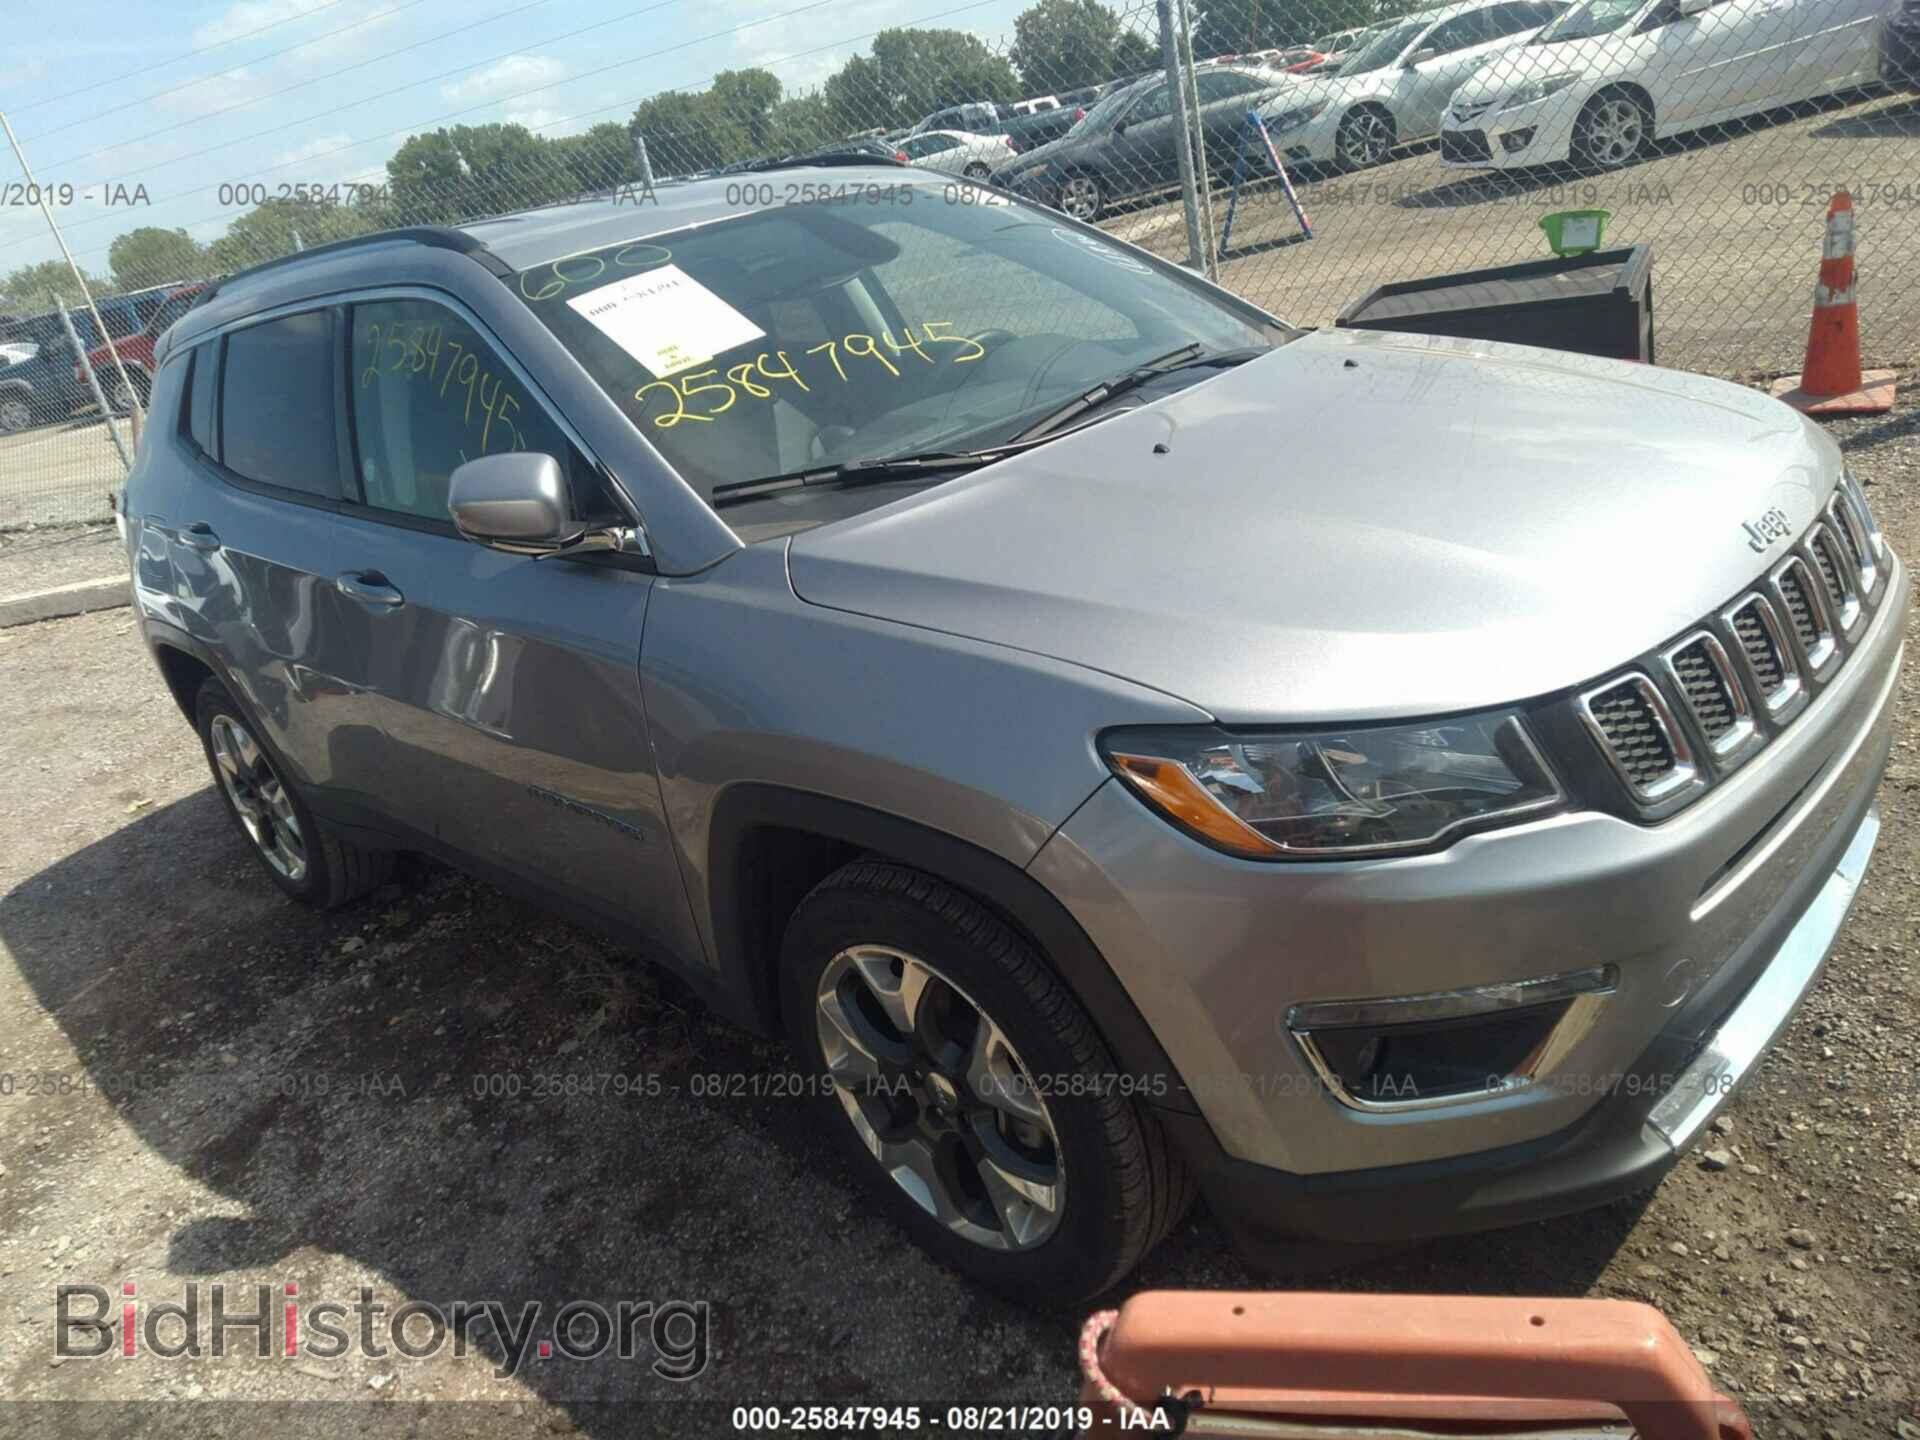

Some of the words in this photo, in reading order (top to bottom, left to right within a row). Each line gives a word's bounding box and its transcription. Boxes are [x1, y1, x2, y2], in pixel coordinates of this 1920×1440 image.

[361, 320, 524, 456] 25847945
[635, 322, 987, 428] 25847945
[1741, 506, 1792, 554] Jeep
